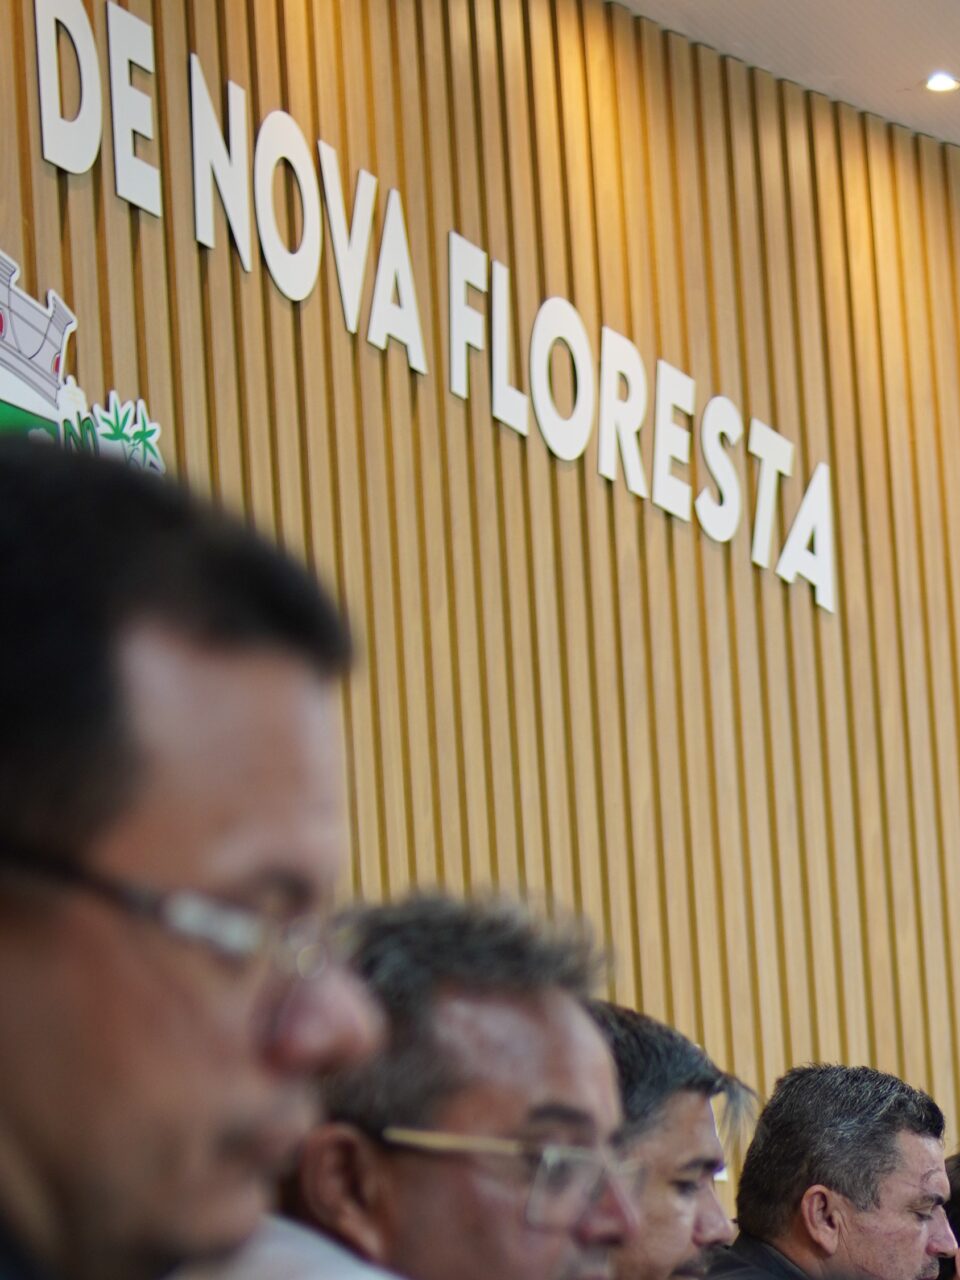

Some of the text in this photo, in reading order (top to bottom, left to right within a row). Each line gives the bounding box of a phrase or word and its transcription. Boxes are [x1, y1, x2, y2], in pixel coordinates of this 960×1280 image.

[34, 0, 835, 614] DE NOVA FLORESTA
